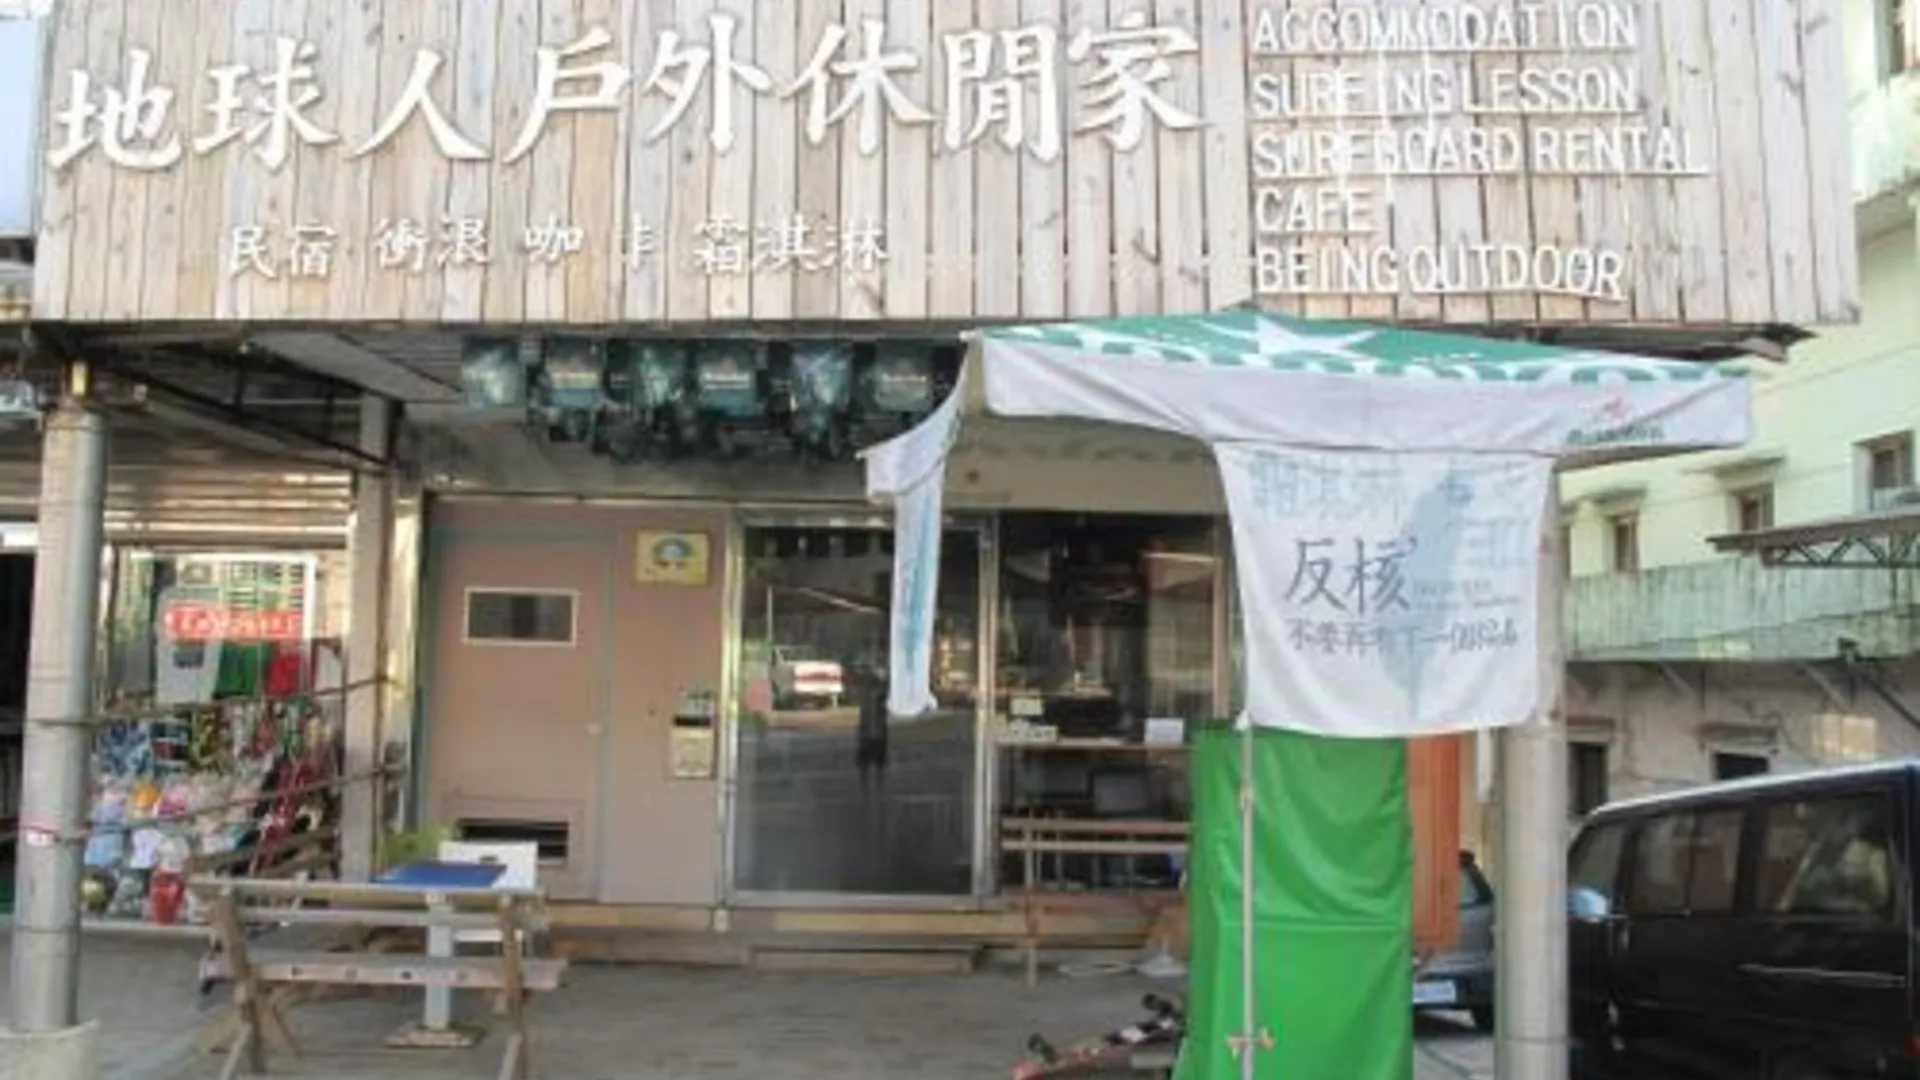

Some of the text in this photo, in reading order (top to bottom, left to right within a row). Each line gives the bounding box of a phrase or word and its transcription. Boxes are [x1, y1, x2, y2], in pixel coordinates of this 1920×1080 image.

[1252, 3, 1638, 53] ACCOMMODATION
[48, 13, 1208, 171] 地球人戶外休閒家
[1252, 66, 1640, 118] SURFING LESSON
[1252, 124, 1711, 178] SURFBOARD RENTAL
[1254, 185, 1376, 234] CAFE
[226, 222, 335, 280] 民宿
[693, 212, 890, 275] 霜淇淋
[1255, 243, 1627, 302] BEING OUTDOOR
